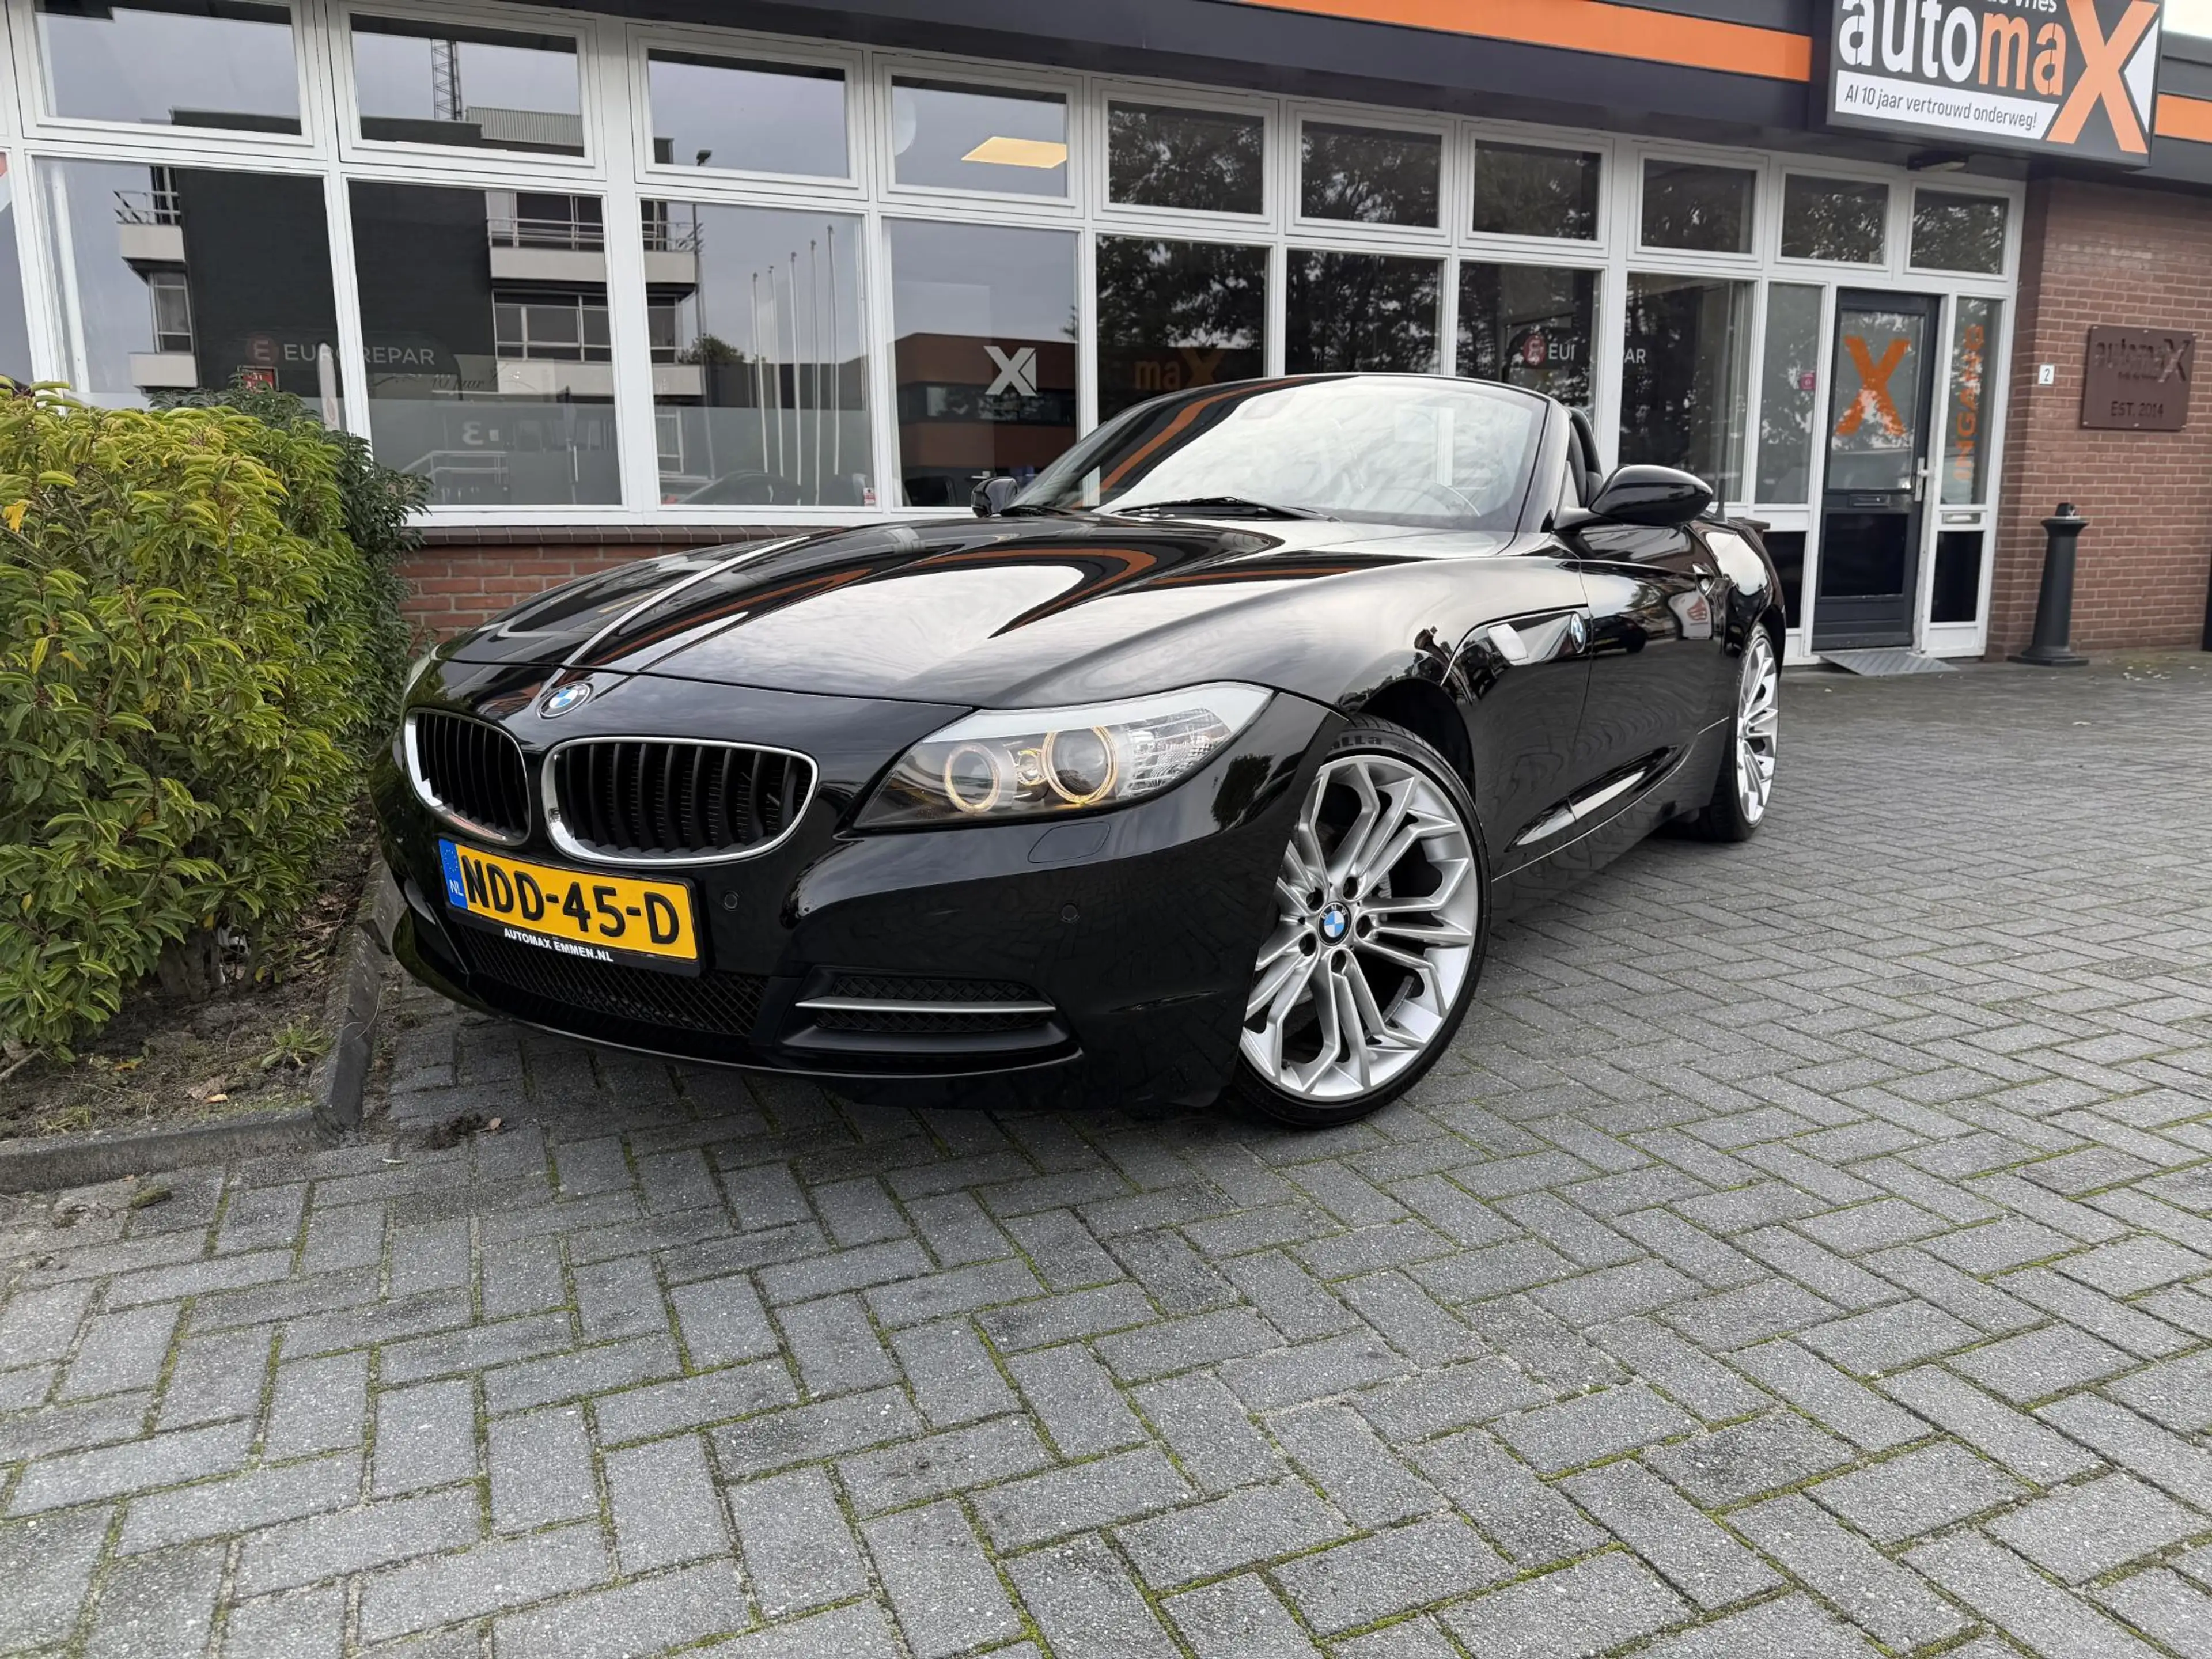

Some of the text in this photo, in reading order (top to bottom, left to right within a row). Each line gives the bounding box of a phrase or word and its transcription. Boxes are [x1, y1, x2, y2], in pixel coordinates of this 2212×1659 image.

[1839, 0, 2159, 154] automaX
[1861, 86, 1876, 105] 10
[1876, 89, 1904, 109] jaar
[1907, 99, 1971, 119] vertrouwd
[1974, 106, 2037, 131] onderweg!
[2044, 368, 2051, 382] 2
[2138, 403, 2164, 418] 2014
[449, 879, 464, 896] NL
[461, 855, 680, 945] NDD-45-D
[504, 928, 614, 963] AUTOMAX EMMEN.NL
